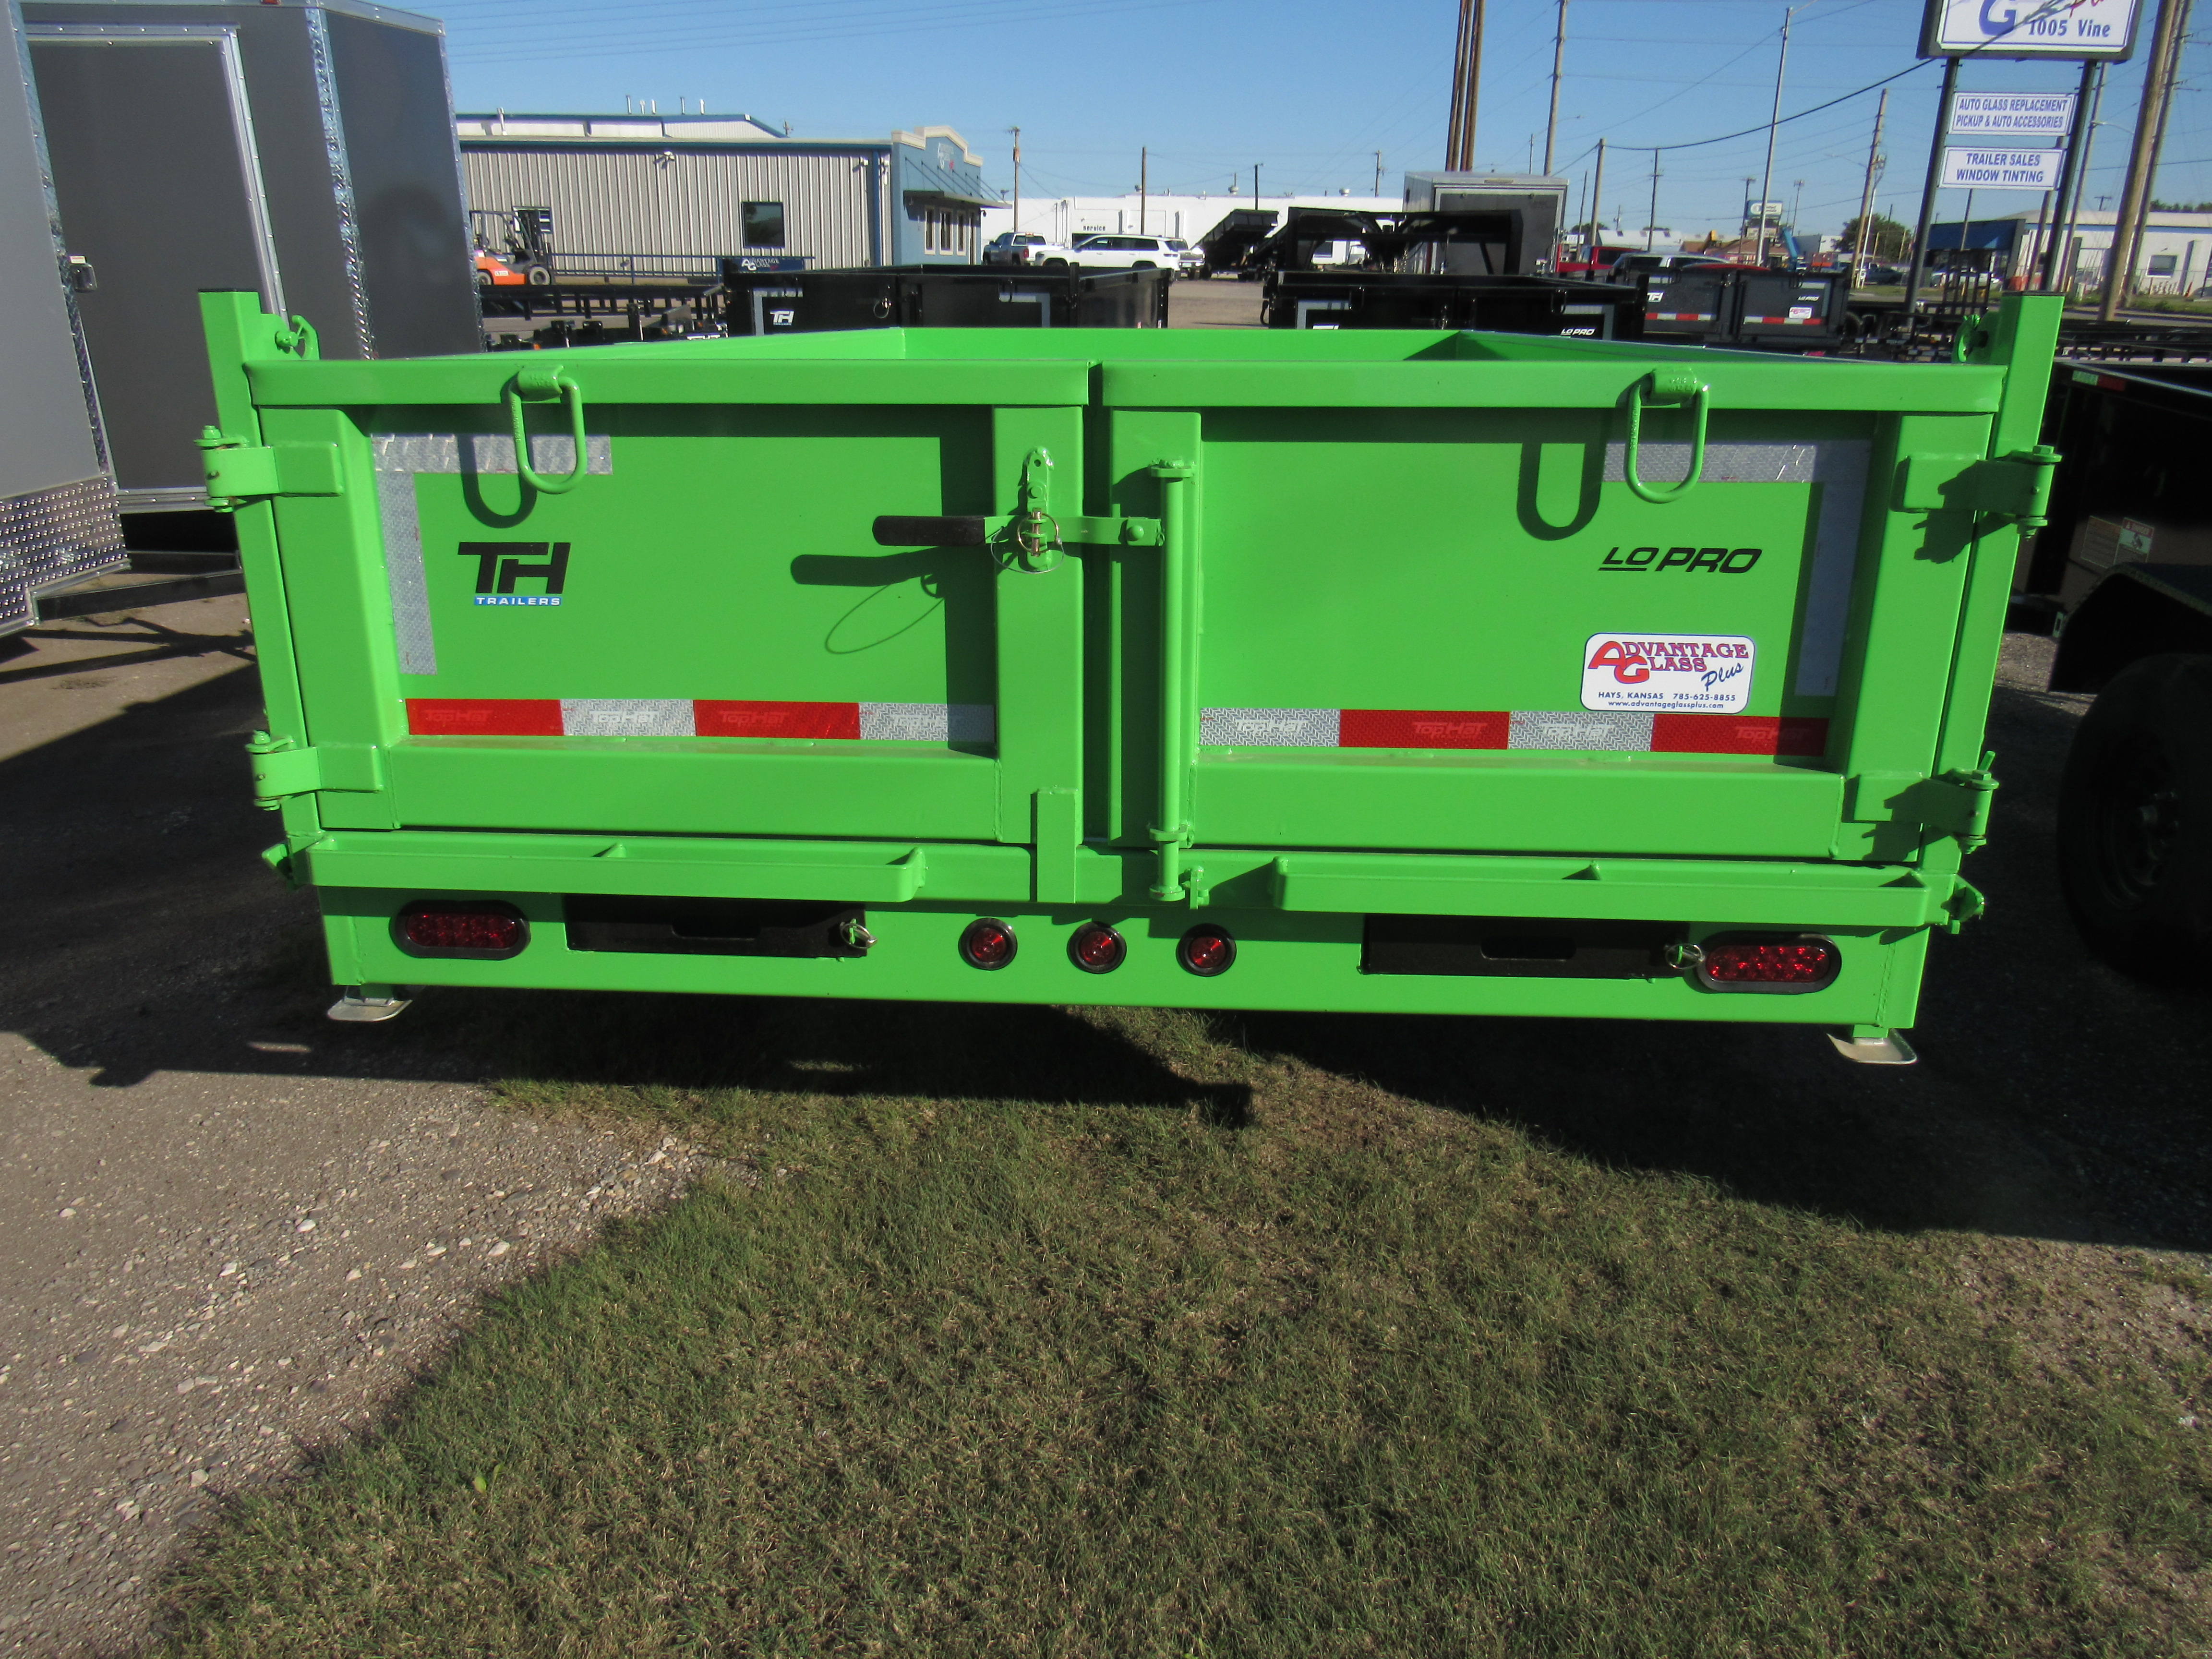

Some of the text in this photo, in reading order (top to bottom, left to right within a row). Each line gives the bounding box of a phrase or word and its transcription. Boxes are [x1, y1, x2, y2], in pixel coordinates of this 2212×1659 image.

[2029, 19, 2111, 38] 1005 Vine
[1959, 98, 2068, 112] AUTO GLASS REPLACEMENT
[1956, 115, 2064, 128] PICKUP & AUTO ACCESSORIES
[1966, 153, 2041, 166] TRAILER SALES
[1956, 169, 2044, 182] WINDOW TINTING
[1602, 547, 1763, 574] LO PRO
[457, 542, 571, 594] TH
[476, 597, 561, 606] TRAILERS
[1587, 641, 1749, 669] ADVANTAGE
[1614, 656, 1707, 684] GLASS
[1701, 663, 1744, 691] Plus
[1673, 693, 1736, 701] 785-625-8855
[1608, 701, 1724, 709] www.advantageglassplus.com
